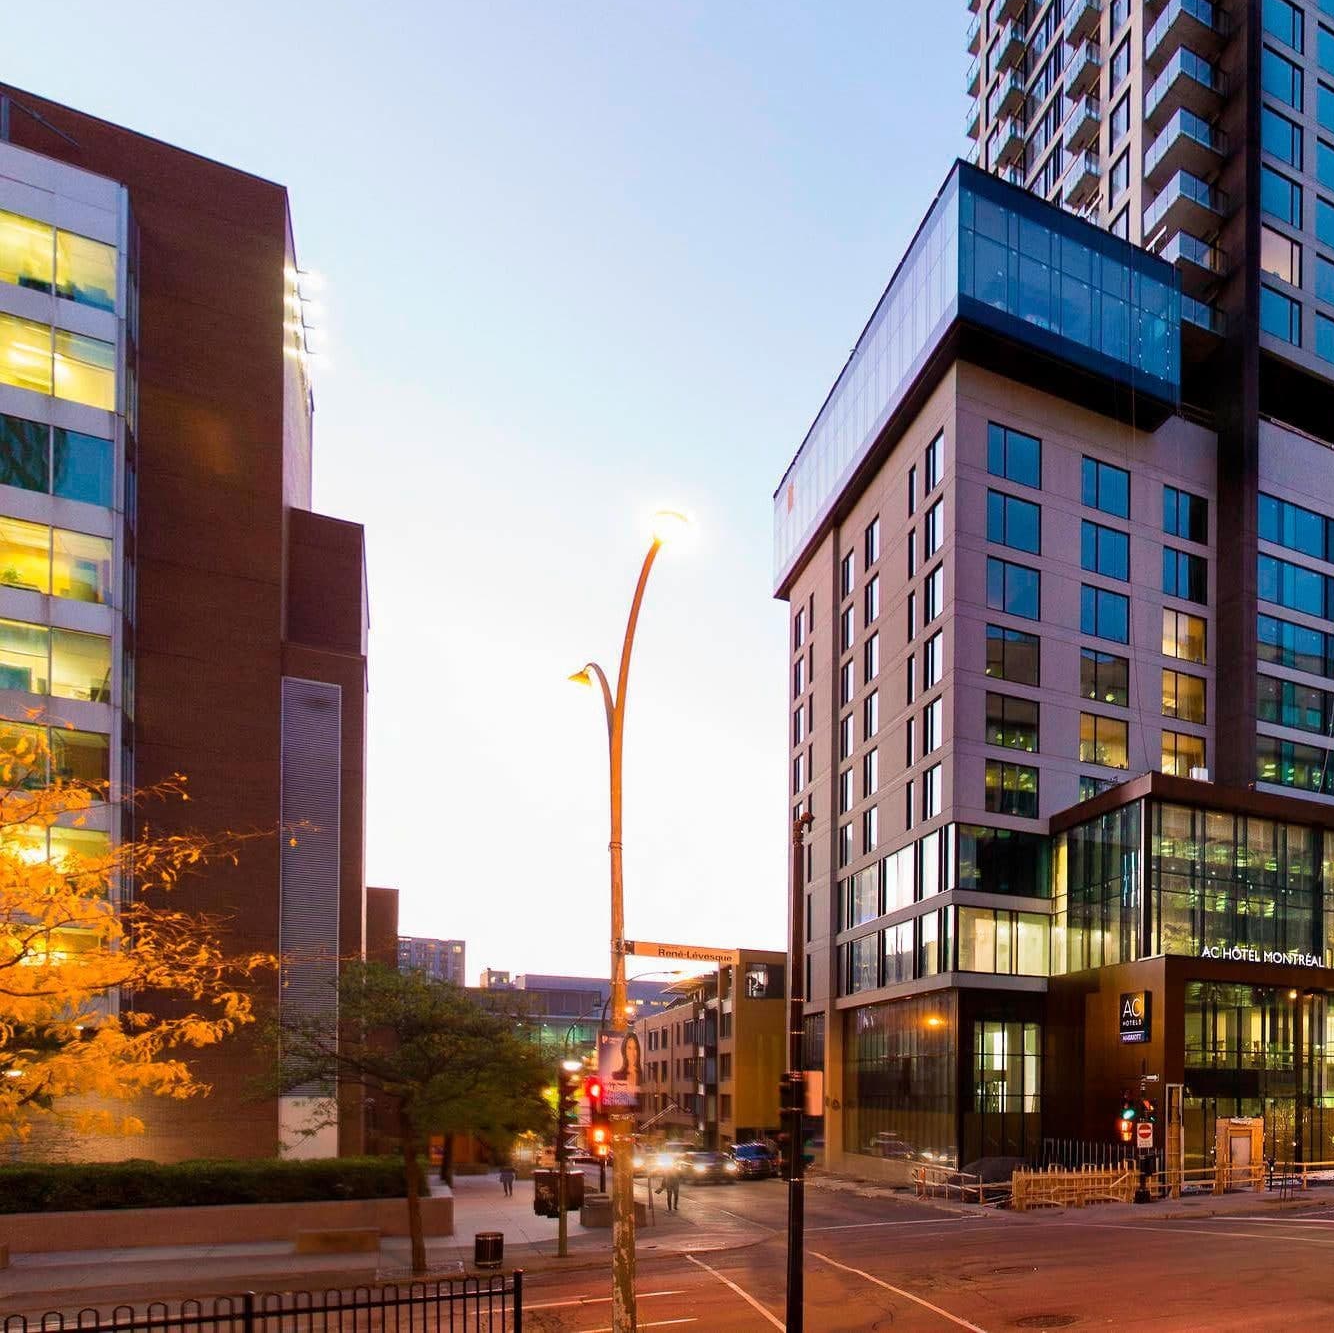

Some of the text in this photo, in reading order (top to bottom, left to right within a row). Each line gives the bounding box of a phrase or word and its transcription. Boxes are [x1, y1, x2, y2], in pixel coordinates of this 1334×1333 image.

[658, 948, 733, 963] René-Lévesque
[1201, 945, 1325, 967] AC HÔTEL MONTRÉAL
[1122, 998, 1142, 1017] AC
